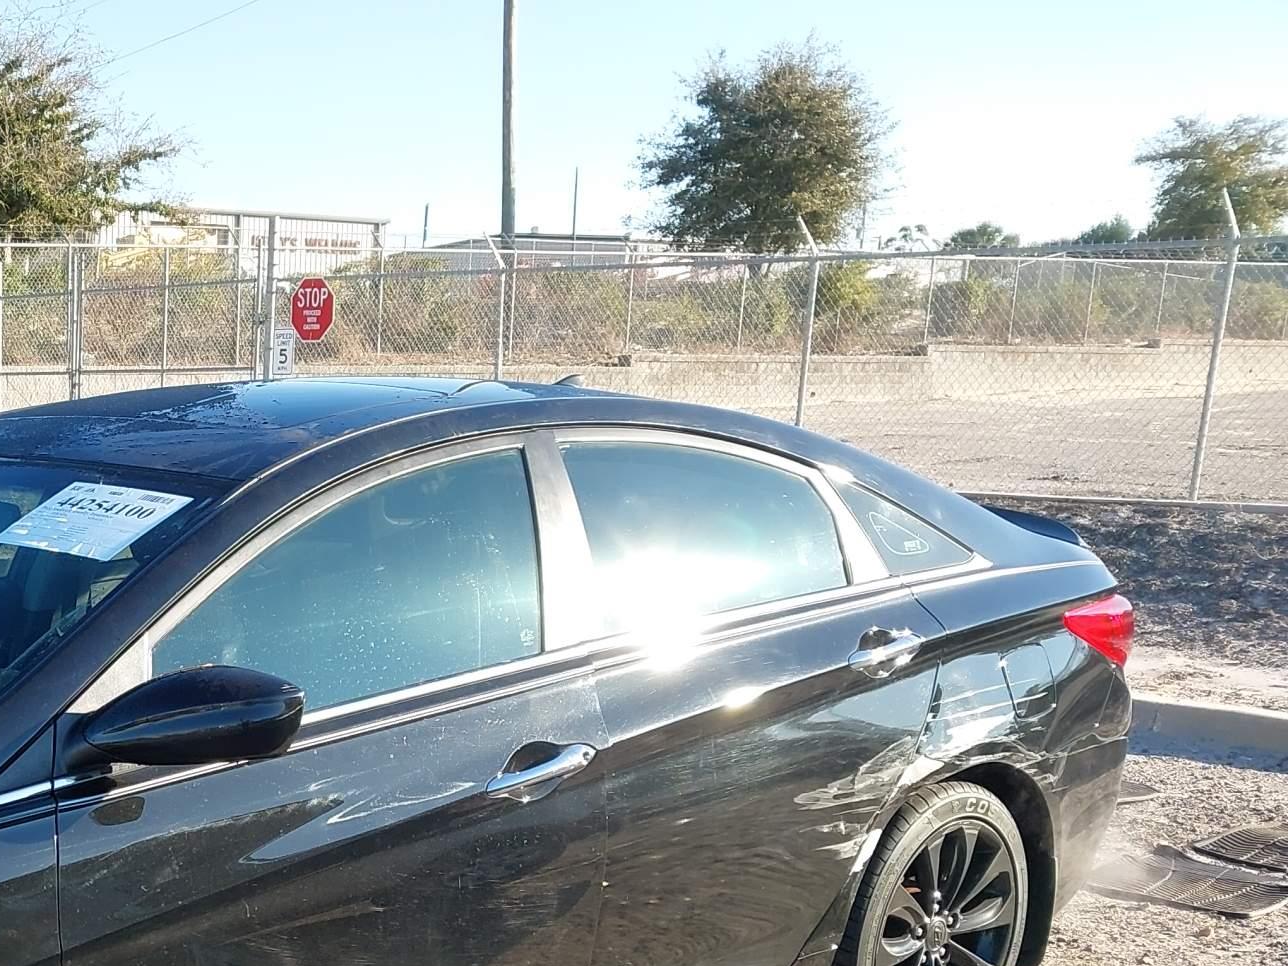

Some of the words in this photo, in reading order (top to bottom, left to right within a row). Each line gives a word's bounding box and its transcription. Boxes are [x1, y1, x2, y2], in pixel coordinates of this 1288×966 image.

[297, 287, 328, 307] STOP
[275, 332, 293, 340] SPEED
[278, 348, 288, 364] 5
[56, 496, 157, 519] 44254100
